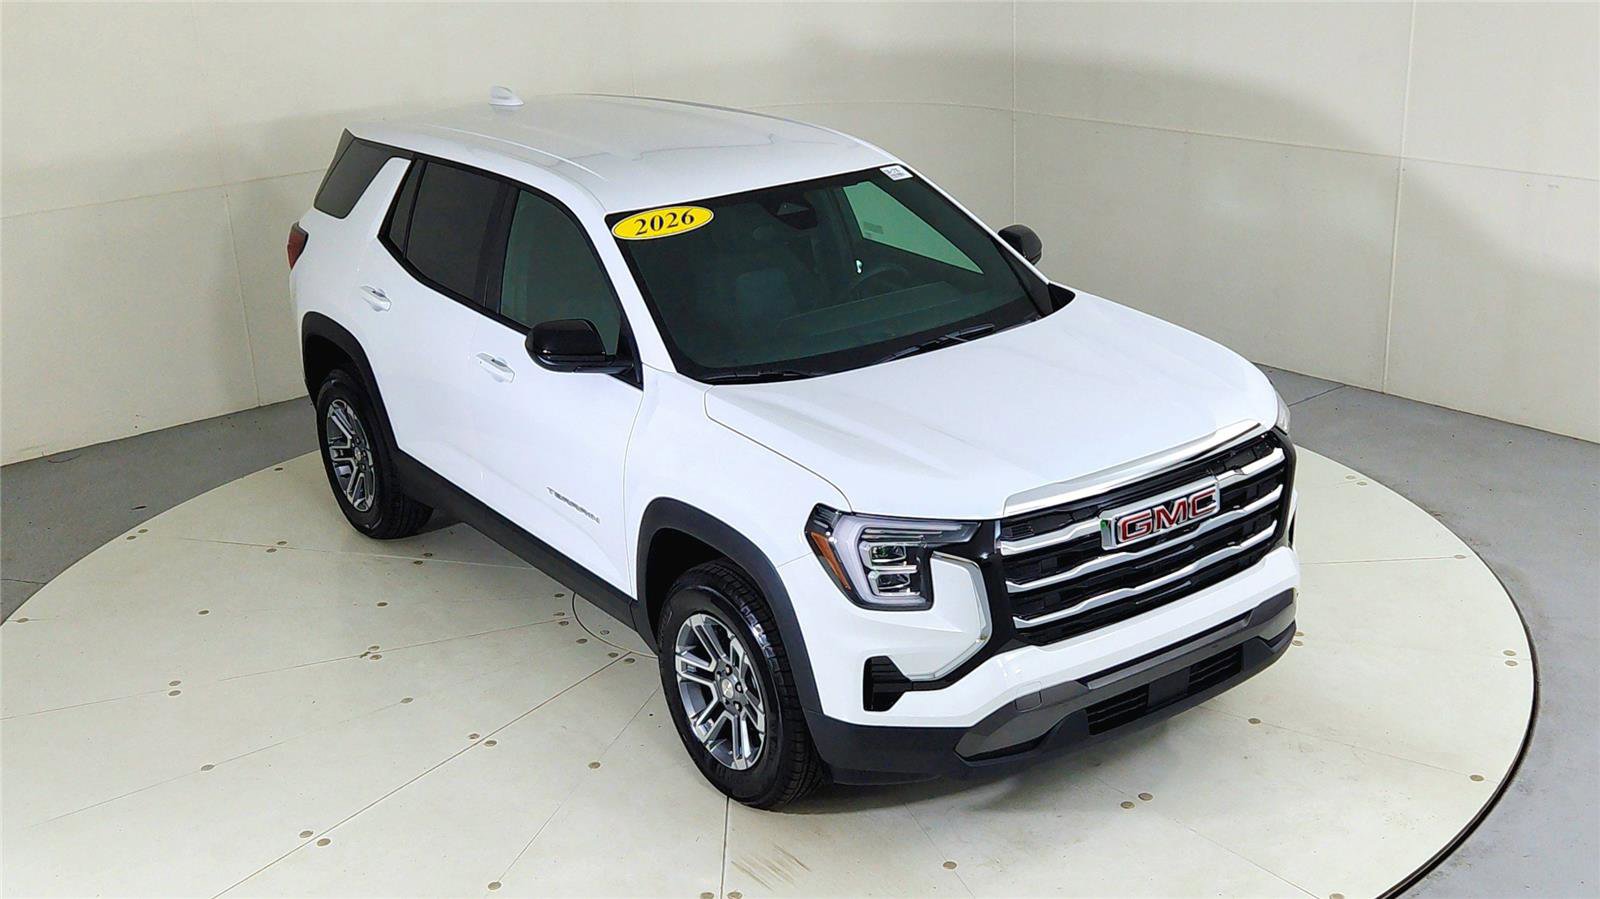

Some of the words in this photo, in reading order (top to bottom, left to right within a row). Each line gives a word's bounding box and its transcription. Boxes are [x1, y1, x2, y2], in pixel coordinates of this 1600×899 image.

[634, 208, 695, 236] 2026
[546, 486, 600, 524] TERRAIN
[1117, 488, 1217, 543] GMC
